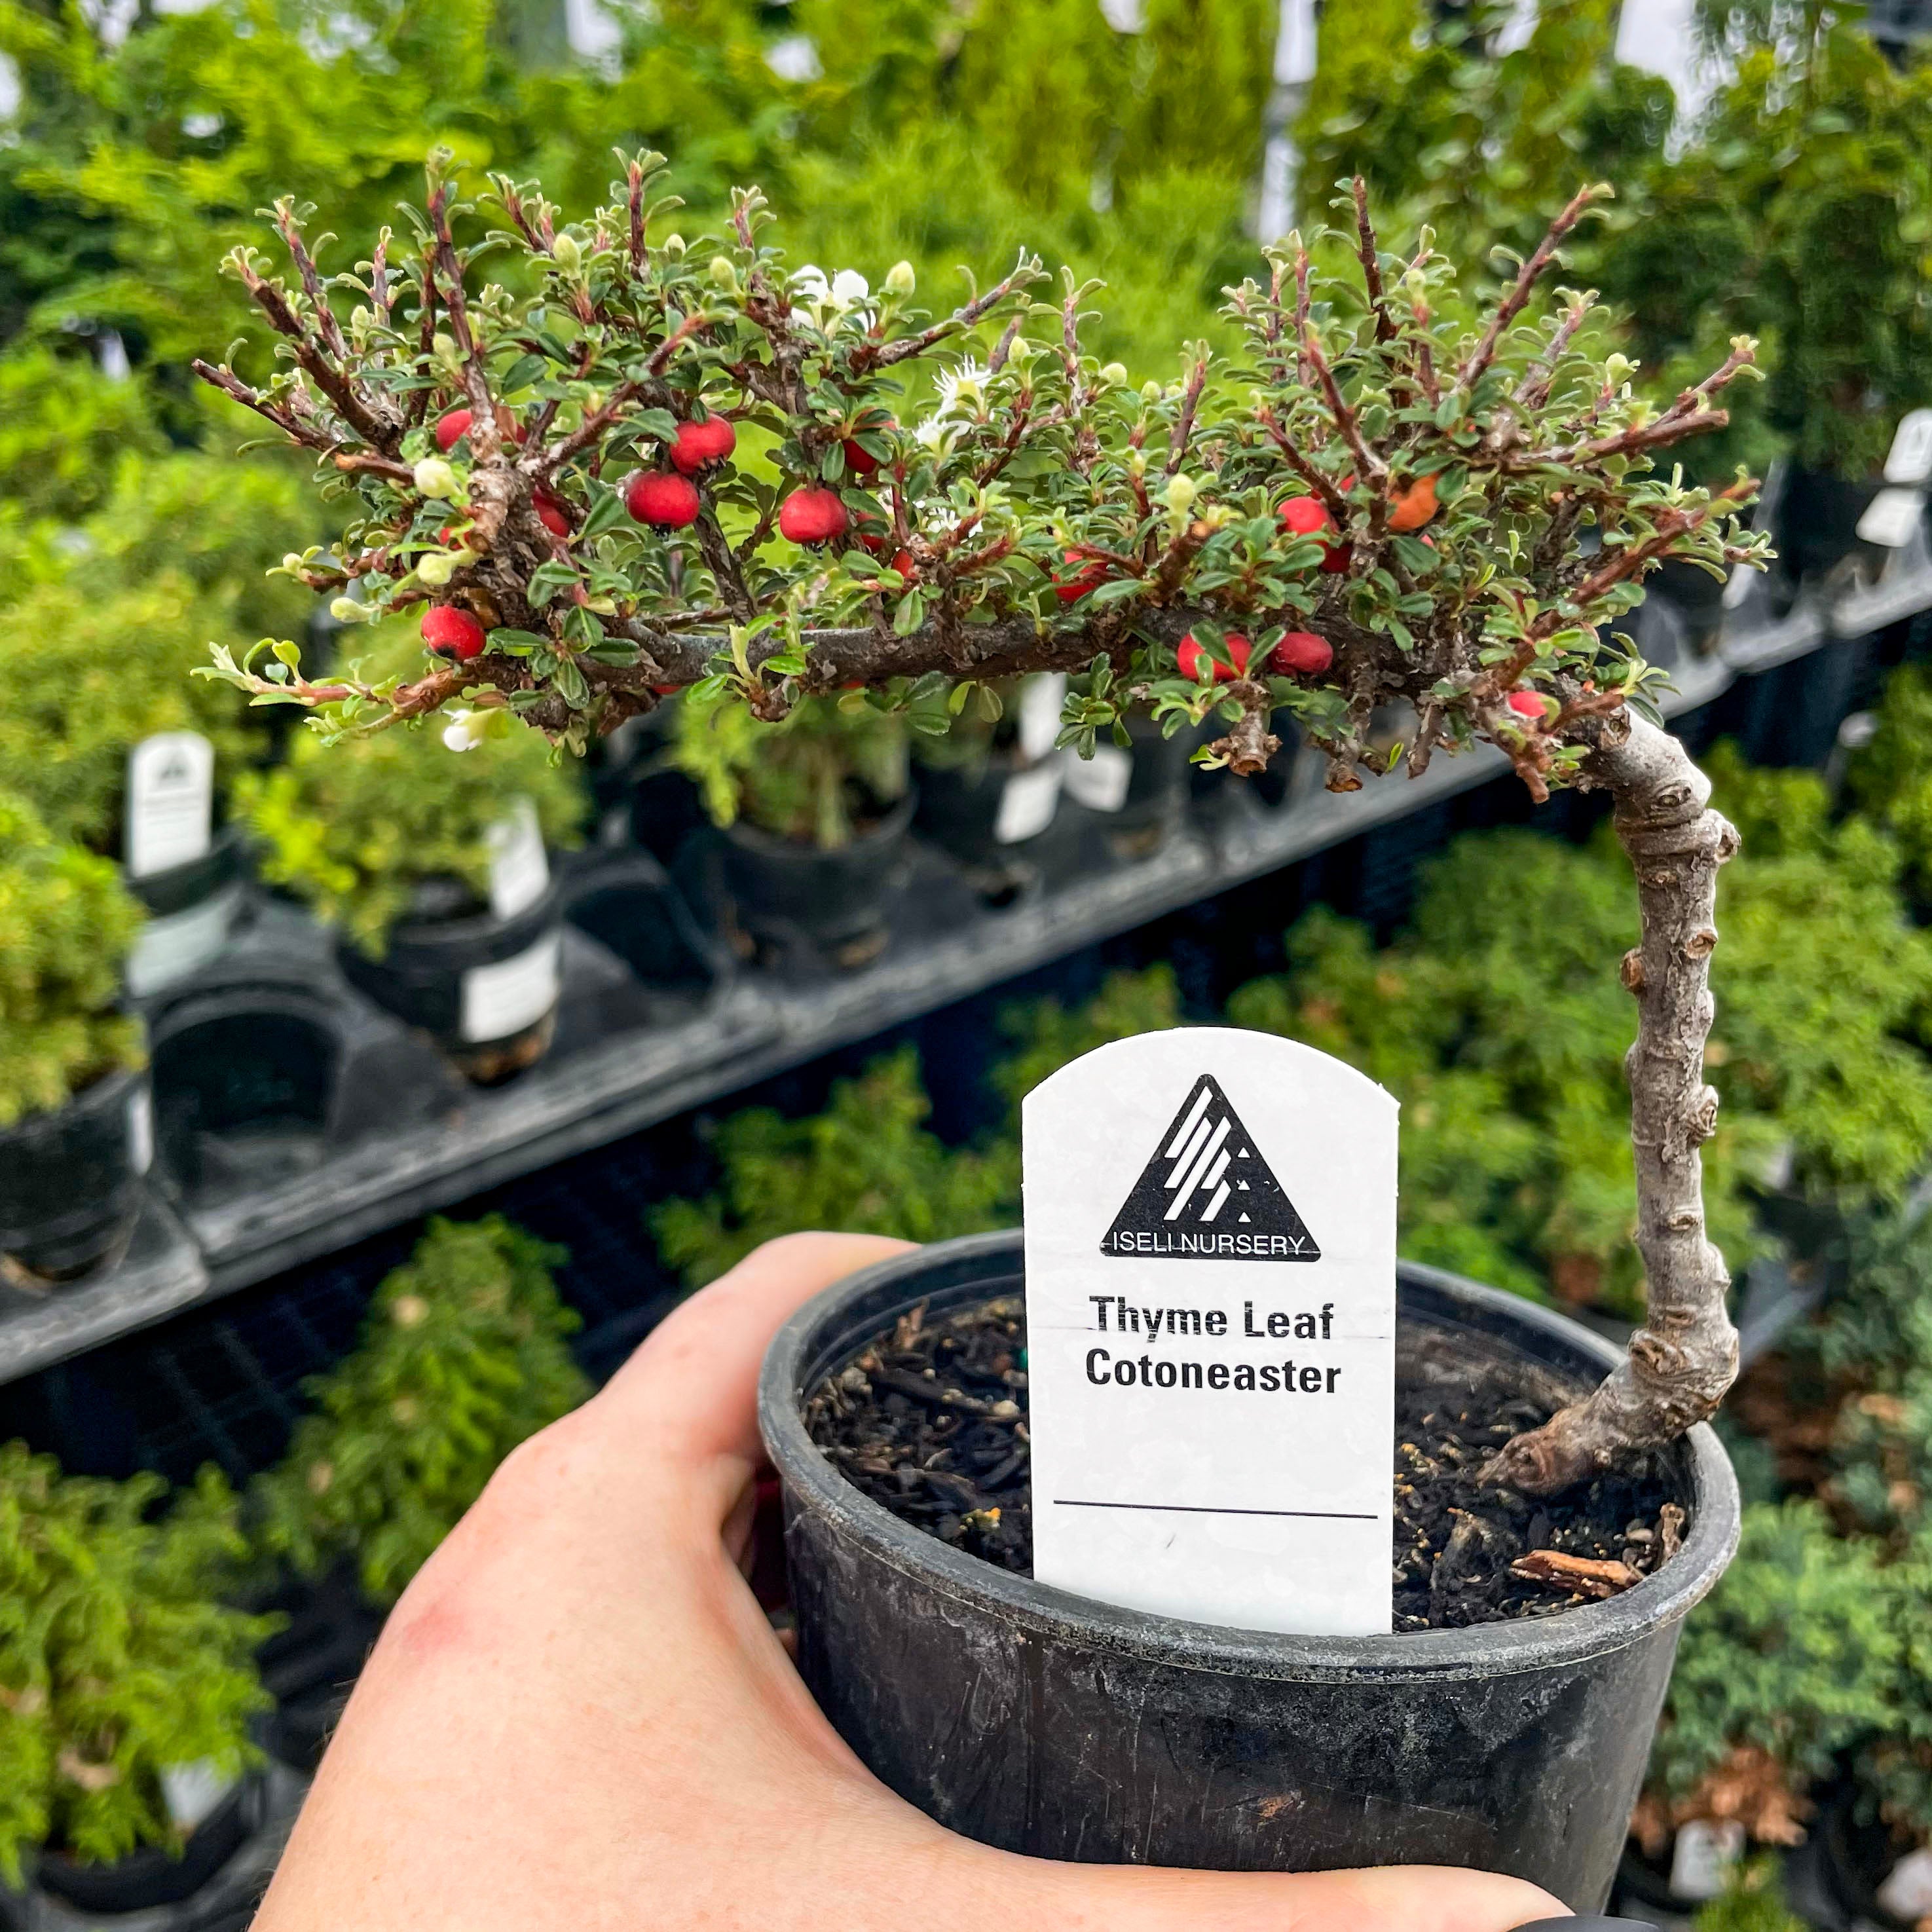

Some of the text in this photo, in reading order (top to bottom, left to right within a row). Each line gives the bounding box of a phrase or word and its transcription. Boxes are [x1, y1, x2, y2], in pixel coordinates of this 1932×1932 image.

[1113, 1231, 1305, 1255] ISELI NURSERY
[1089, 1295, 1334, 1343] Thyme Leaf
[1086, 1348, 1341, 1393] Cotoneaster
